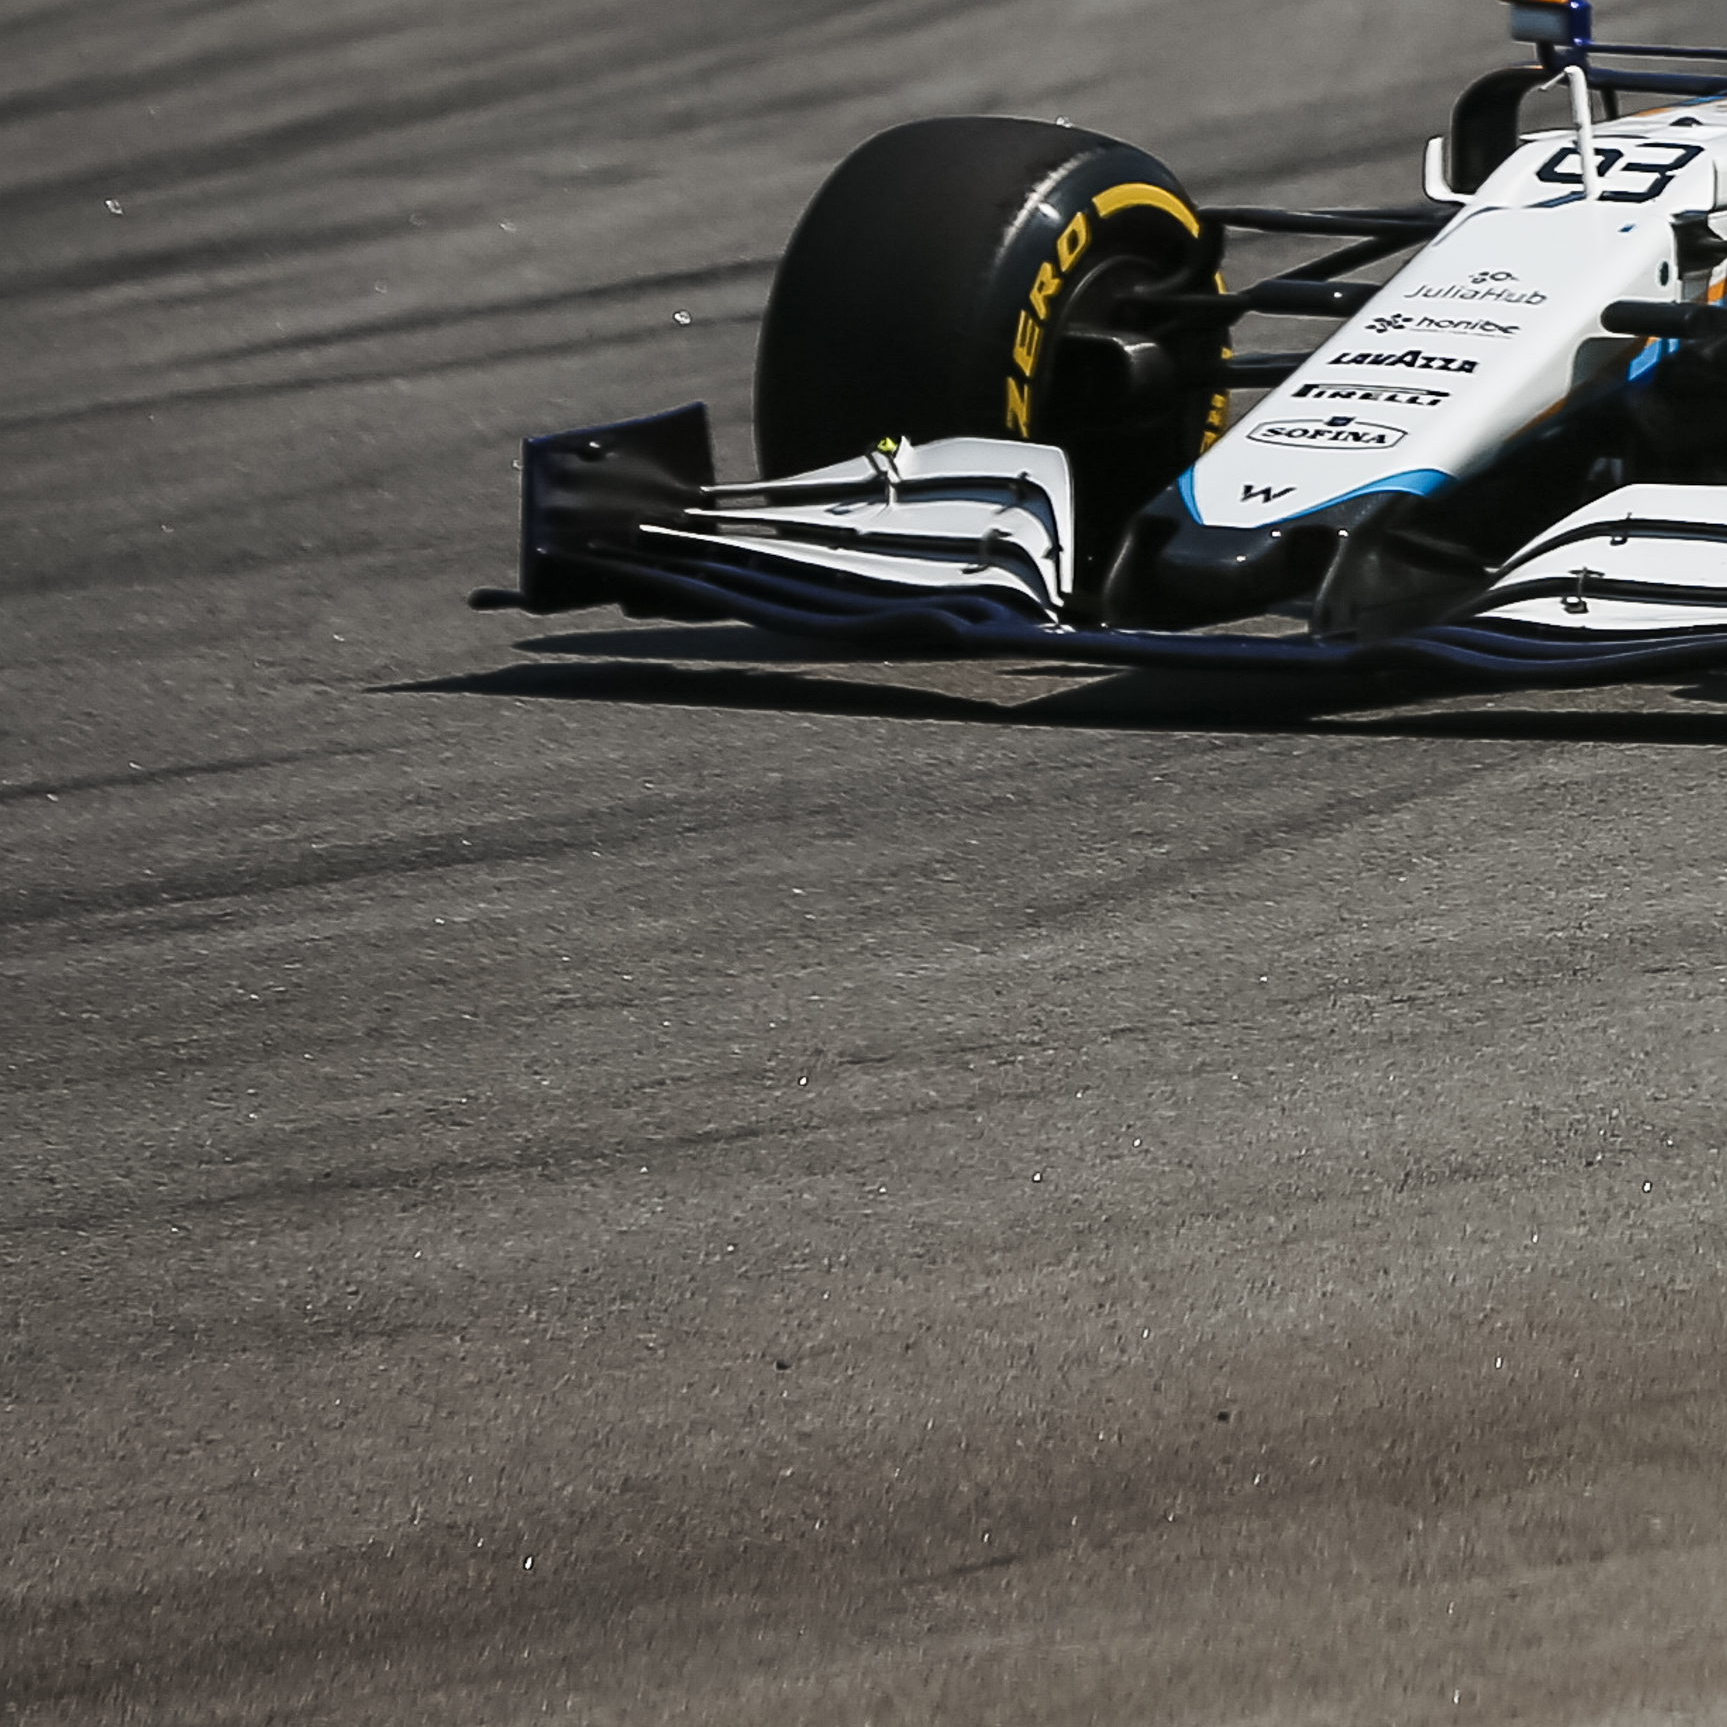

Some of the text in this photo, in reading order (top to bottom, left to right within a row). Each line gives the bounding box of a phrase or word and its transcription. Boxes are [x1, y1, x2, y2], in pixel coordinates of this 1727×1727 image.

[1402, 283, 1548, 306] JuliaHub
[1005, 211, 1090, 439] ZERO
[1327, 349, 1480, 374] LAVAZZA
[1290, 383, 1451, 407] PIRELLI
[1260, 425, 1387, 445] SOFINA
